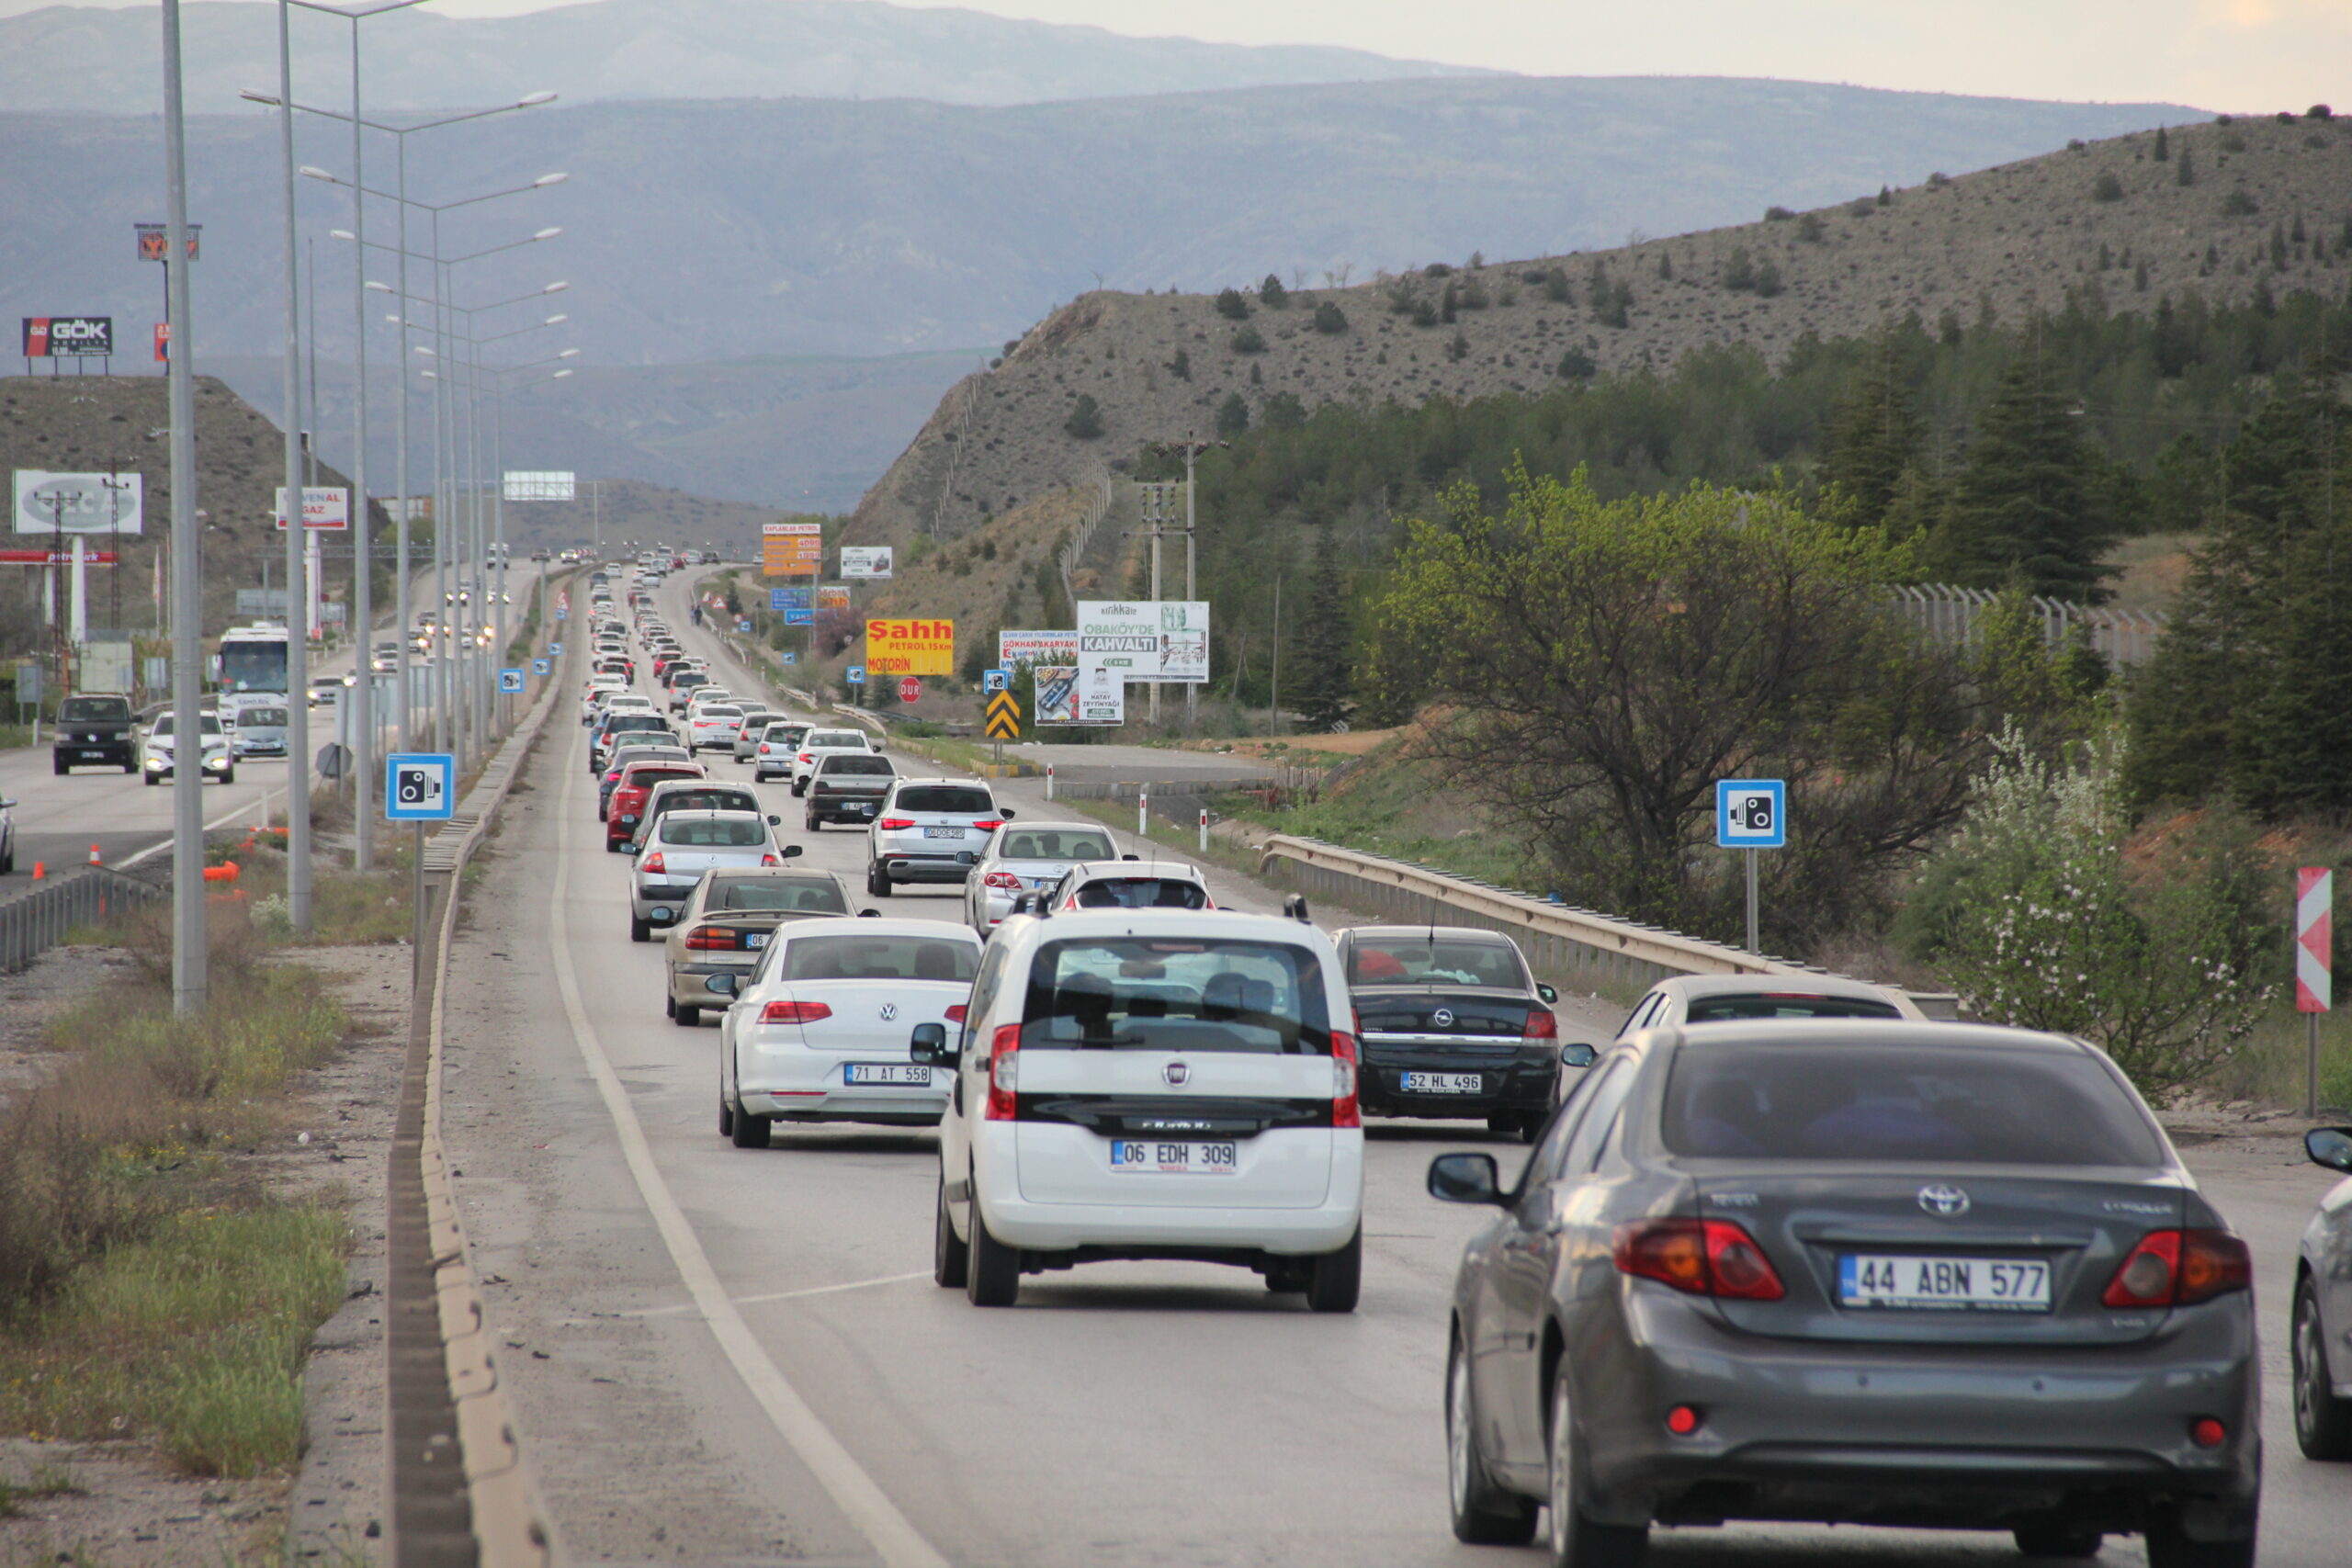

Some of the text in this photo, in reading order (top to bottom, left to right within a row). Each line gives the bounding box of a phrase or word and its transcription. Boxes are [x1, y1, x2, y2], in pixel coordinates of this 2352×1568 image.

[52, 320, 107, 339] GÖK
[868, 621, 952, 641] Şahh
[889, 642, 926, 650] PETROL
[1003, 639, 1036, 648] GÖKHAN
[1084, 637, 1154, 651] KAHVALTI
[867, 655, 910, 671] MOTORİN
[900, 684, 920, 695] DUR
[752, 935, 763, 945] 06
[855, 1066, 928, 1081] 71 AT 558
[1409, 1075, 1478, 1089] 52 HL 496
[1125, 1144, 1145, 1163] 06
[1157, 1144, 1189, 1163] EDH
[1201, 1145, 1232, 1164] 309
[1860, 1261, 1895, 1293] 44
[1917, 1262, 1971, 1295] ABN
[1991, 1264, 2044, 1298] 577
